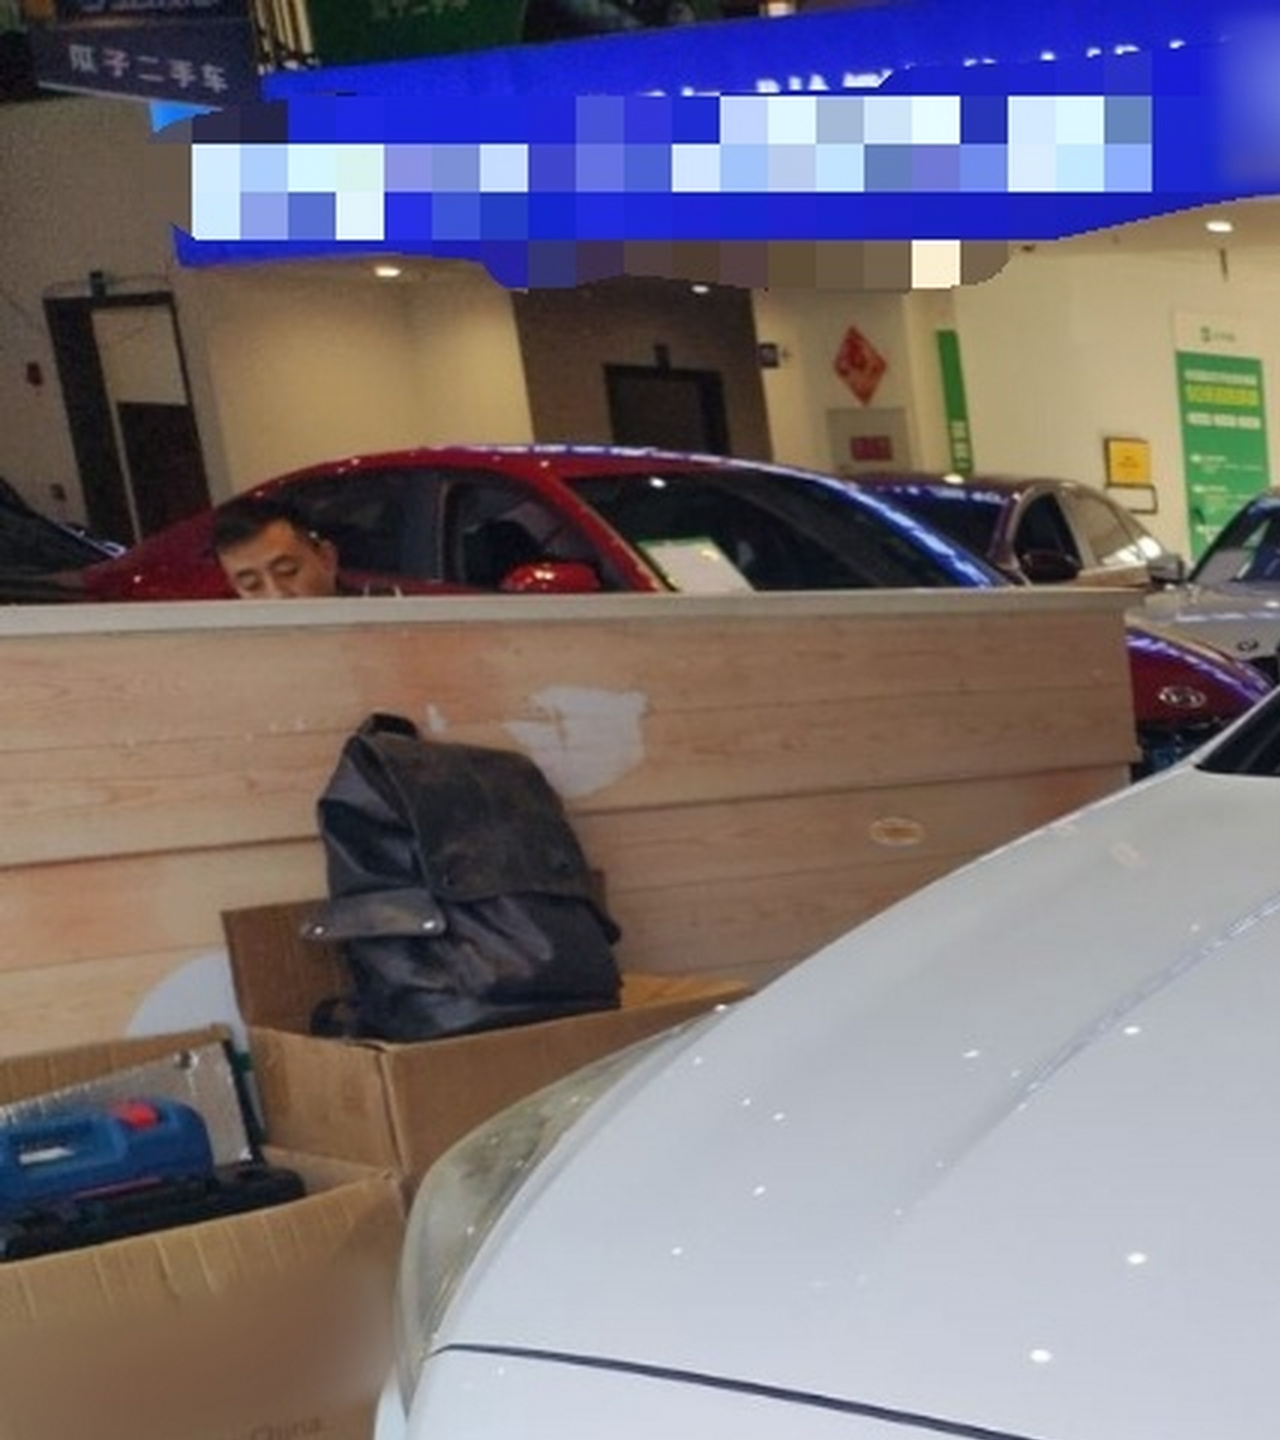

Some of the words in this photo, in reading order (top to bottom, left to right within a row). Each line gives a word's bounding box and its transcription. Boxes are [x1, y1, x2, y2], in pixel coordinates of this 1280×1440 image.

[69, 44, 229, 93] 瓜子二手车
